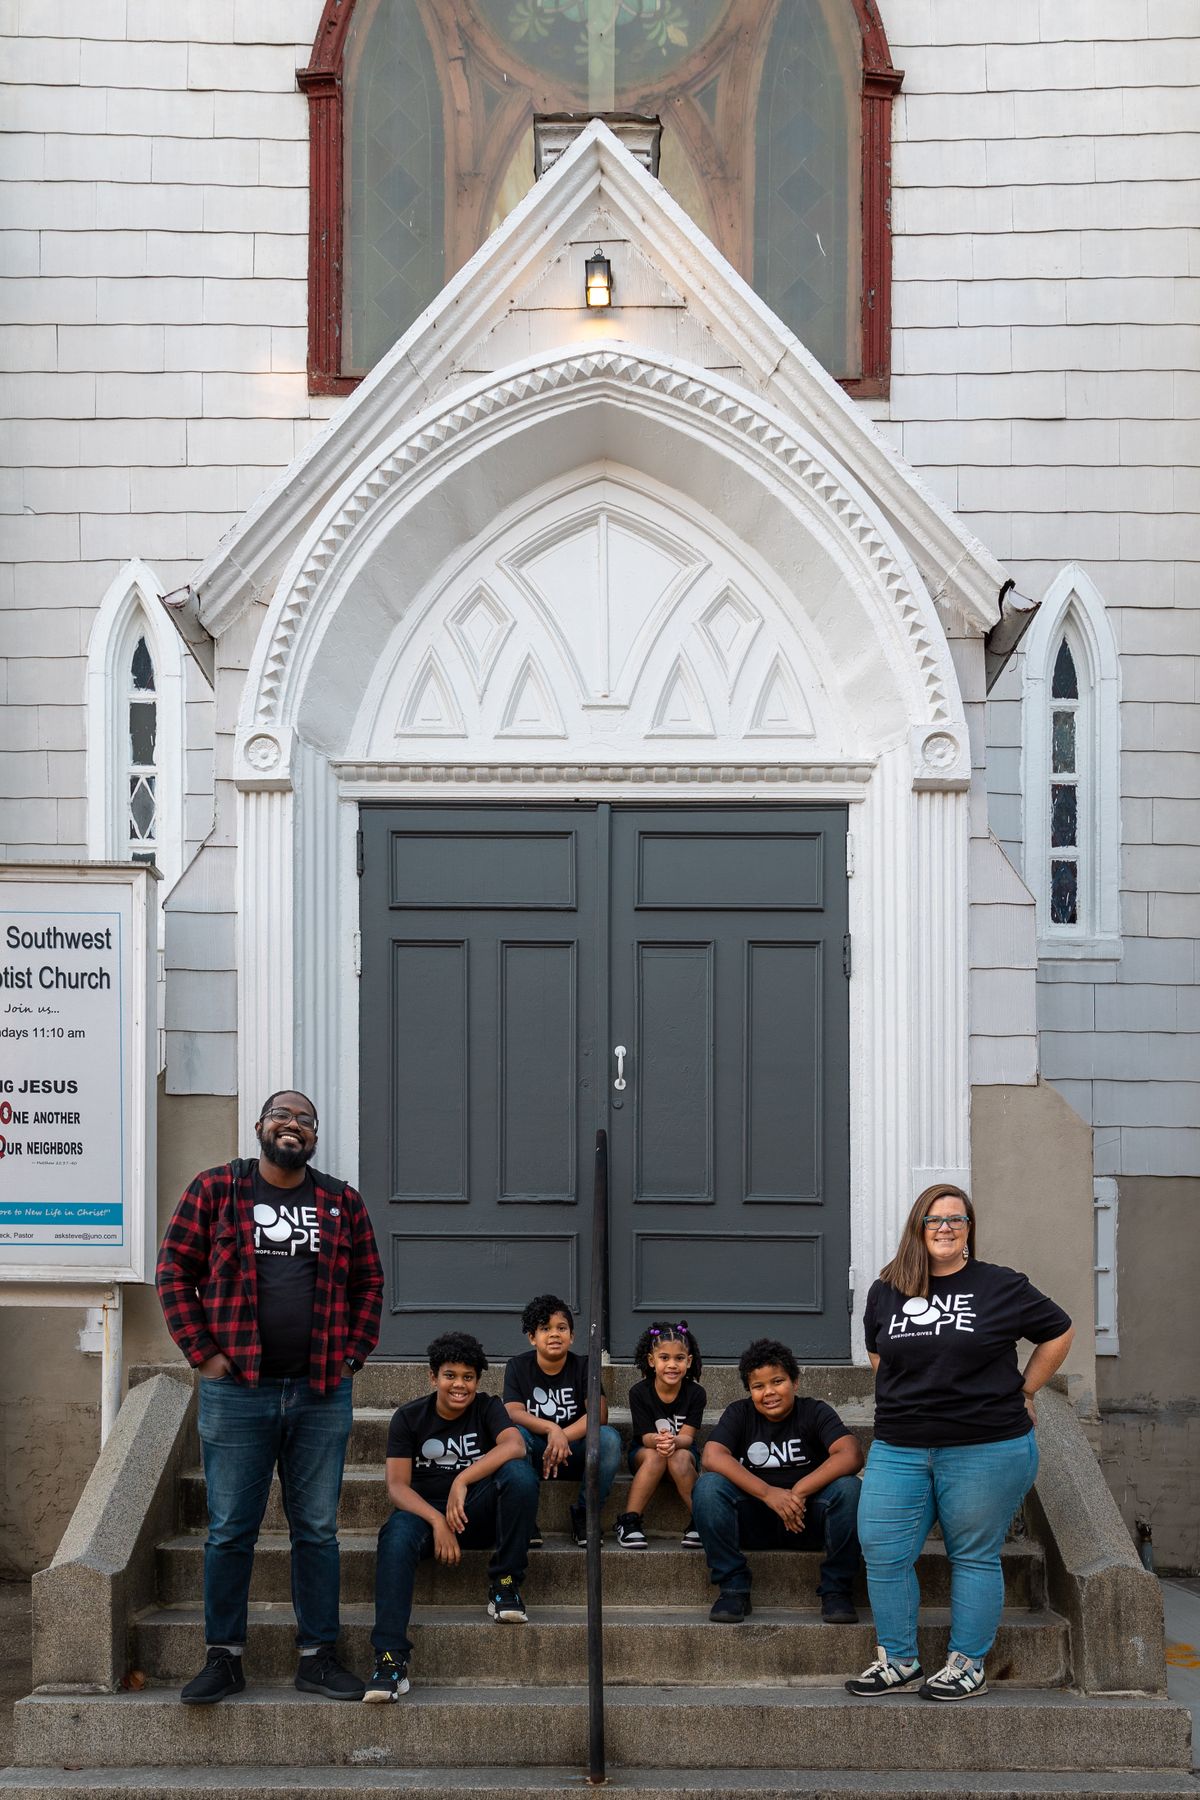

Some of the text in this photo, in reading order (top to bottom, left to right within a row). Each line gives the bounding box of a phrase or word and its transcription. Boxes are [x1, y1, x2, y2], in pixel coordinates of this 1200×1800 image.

[6, 925, 112, 949] Southwest
[39, 966, 110, 989] Church
[4, 1003, 33, 1013] Join
[0, 1027, 86, 1040] days 11:10 am
[18, 1080, 78, 1093] JESUS
[33, 1112, 81, 1124] ANOTHER
[27, 1142, 83, 1155] NEIGHBORS
[25, 1208, 42, 1216] New
[45, 1208, 62, 1217] Life
[54, 1232, 118, 1240] asksteve@juno.com
[902, 1294, 974, 1316] ONE
[888, 1305, 977, 1336] HOPE
[533, 1386, 575, 1405] ONE
[421, 1432, 481, 1460] ONE
[747, 1438, 806, 1466] ONE
